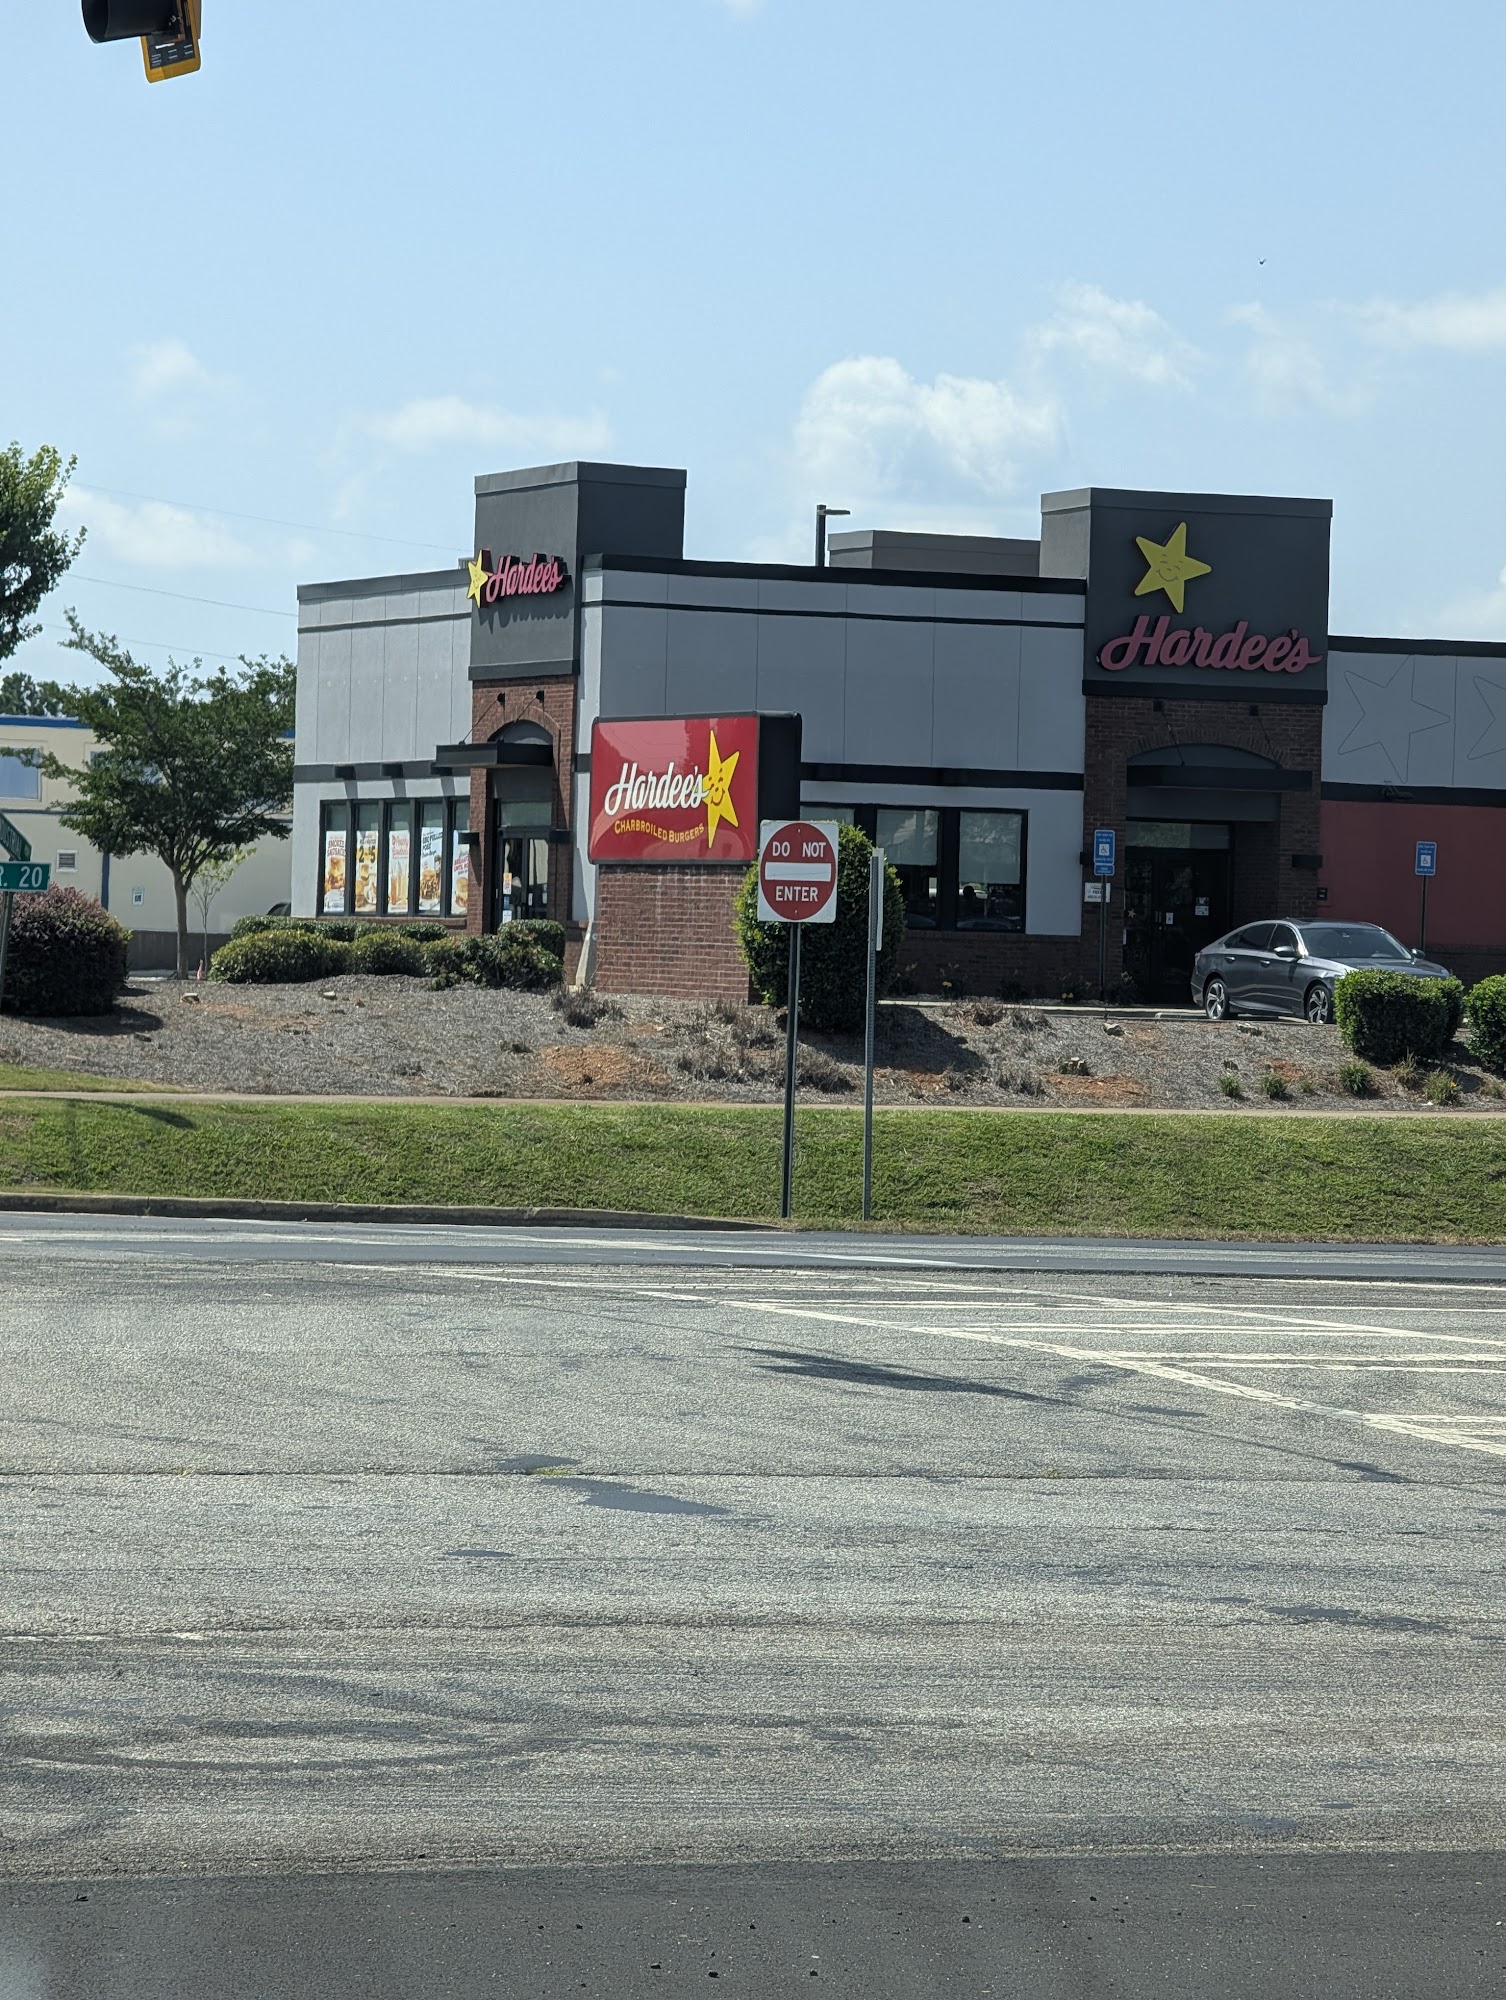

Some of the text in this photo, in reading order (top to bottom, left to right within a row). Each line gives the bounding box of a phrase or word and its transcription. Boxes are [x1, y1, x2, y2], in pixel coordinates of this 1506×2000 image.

[486, 553, 563, 602] Hardee's
[1100, 615, 1324, 673] Hardee's
[604, 762, 710, 816] Hardee's
[614, 819, 705, 843] CHARBROILED BURGERS
[772, 842, 826, 858] DO NOT
[19, 866, 42, 888] 20
[776, 885, 818, 902] ENTER
